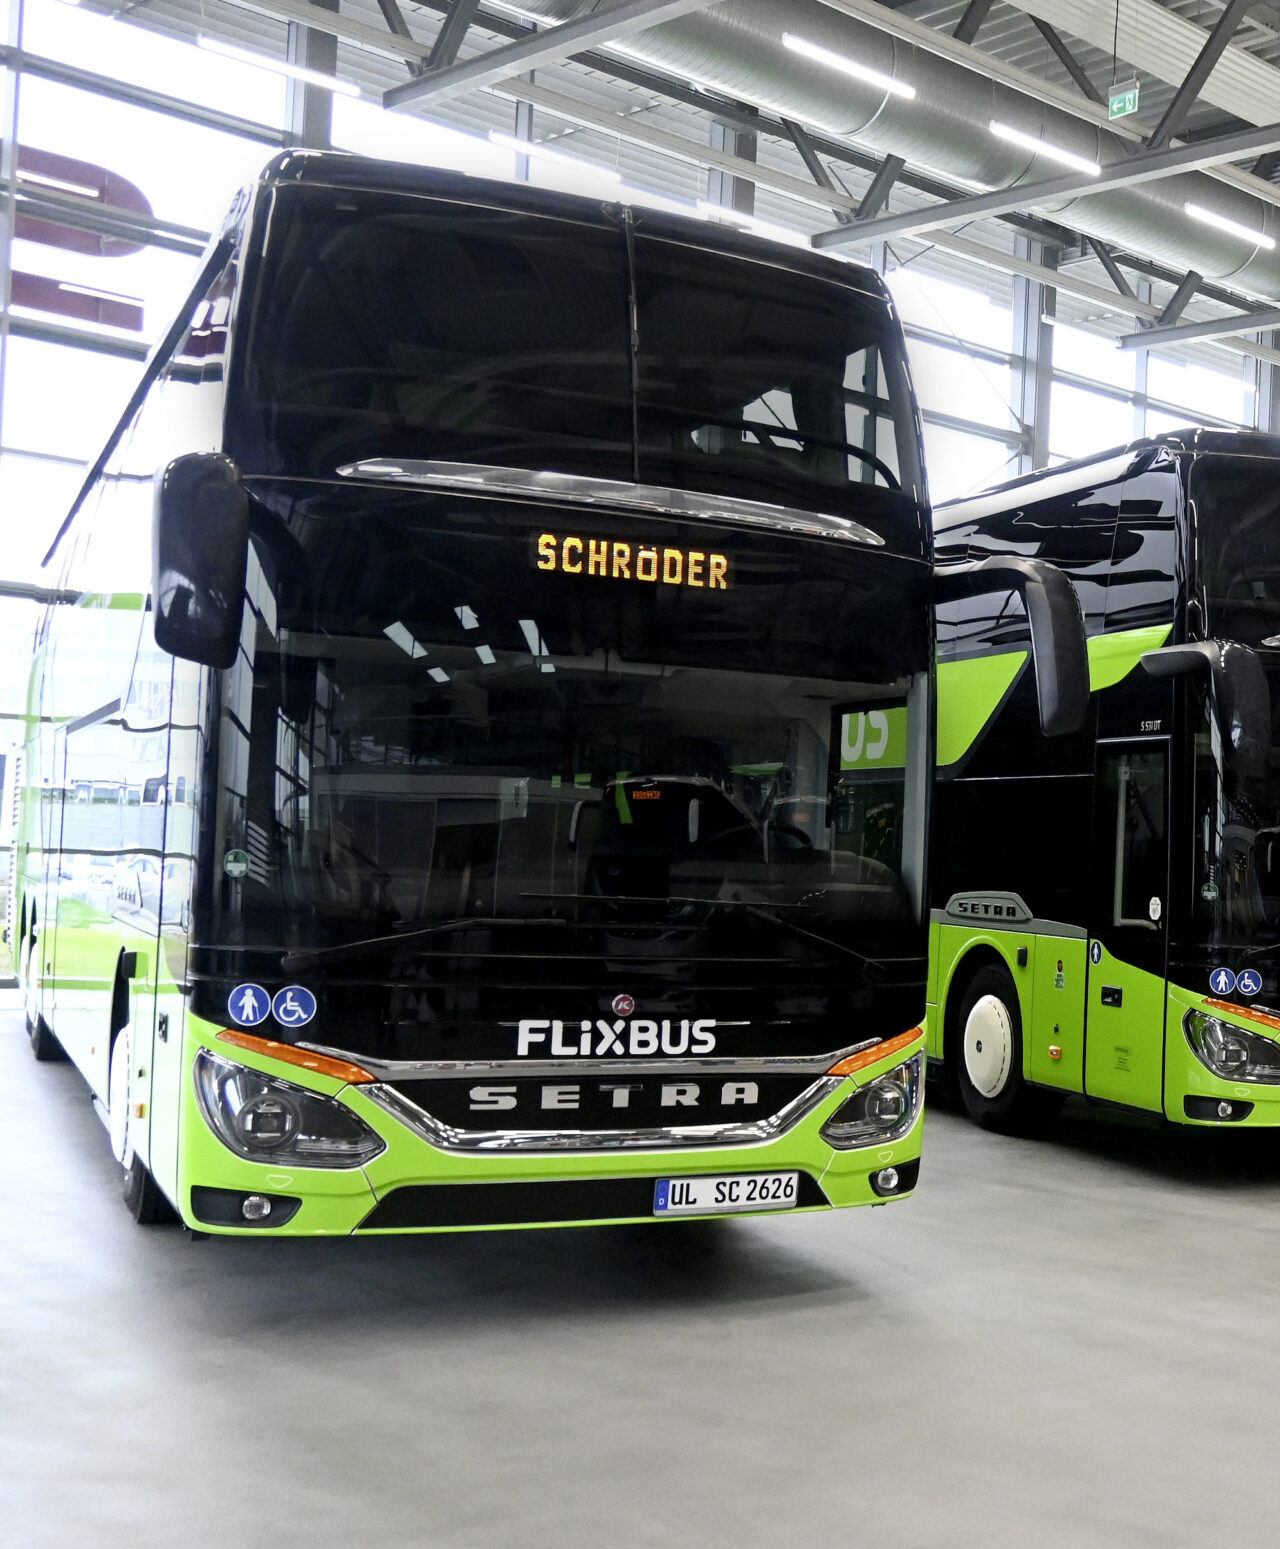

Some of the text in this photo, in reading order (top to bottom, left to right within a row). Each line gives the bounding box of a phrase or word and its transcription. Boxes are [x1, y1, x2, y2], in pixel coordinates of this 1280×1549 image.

[538, 534, 728, 589] SCHRÖDER
[959, 901, 1016, 917] SETRA
[469, 1082, 759, 1110] SETRA
[671, 1177, 794, 1206] UL SC 2626
